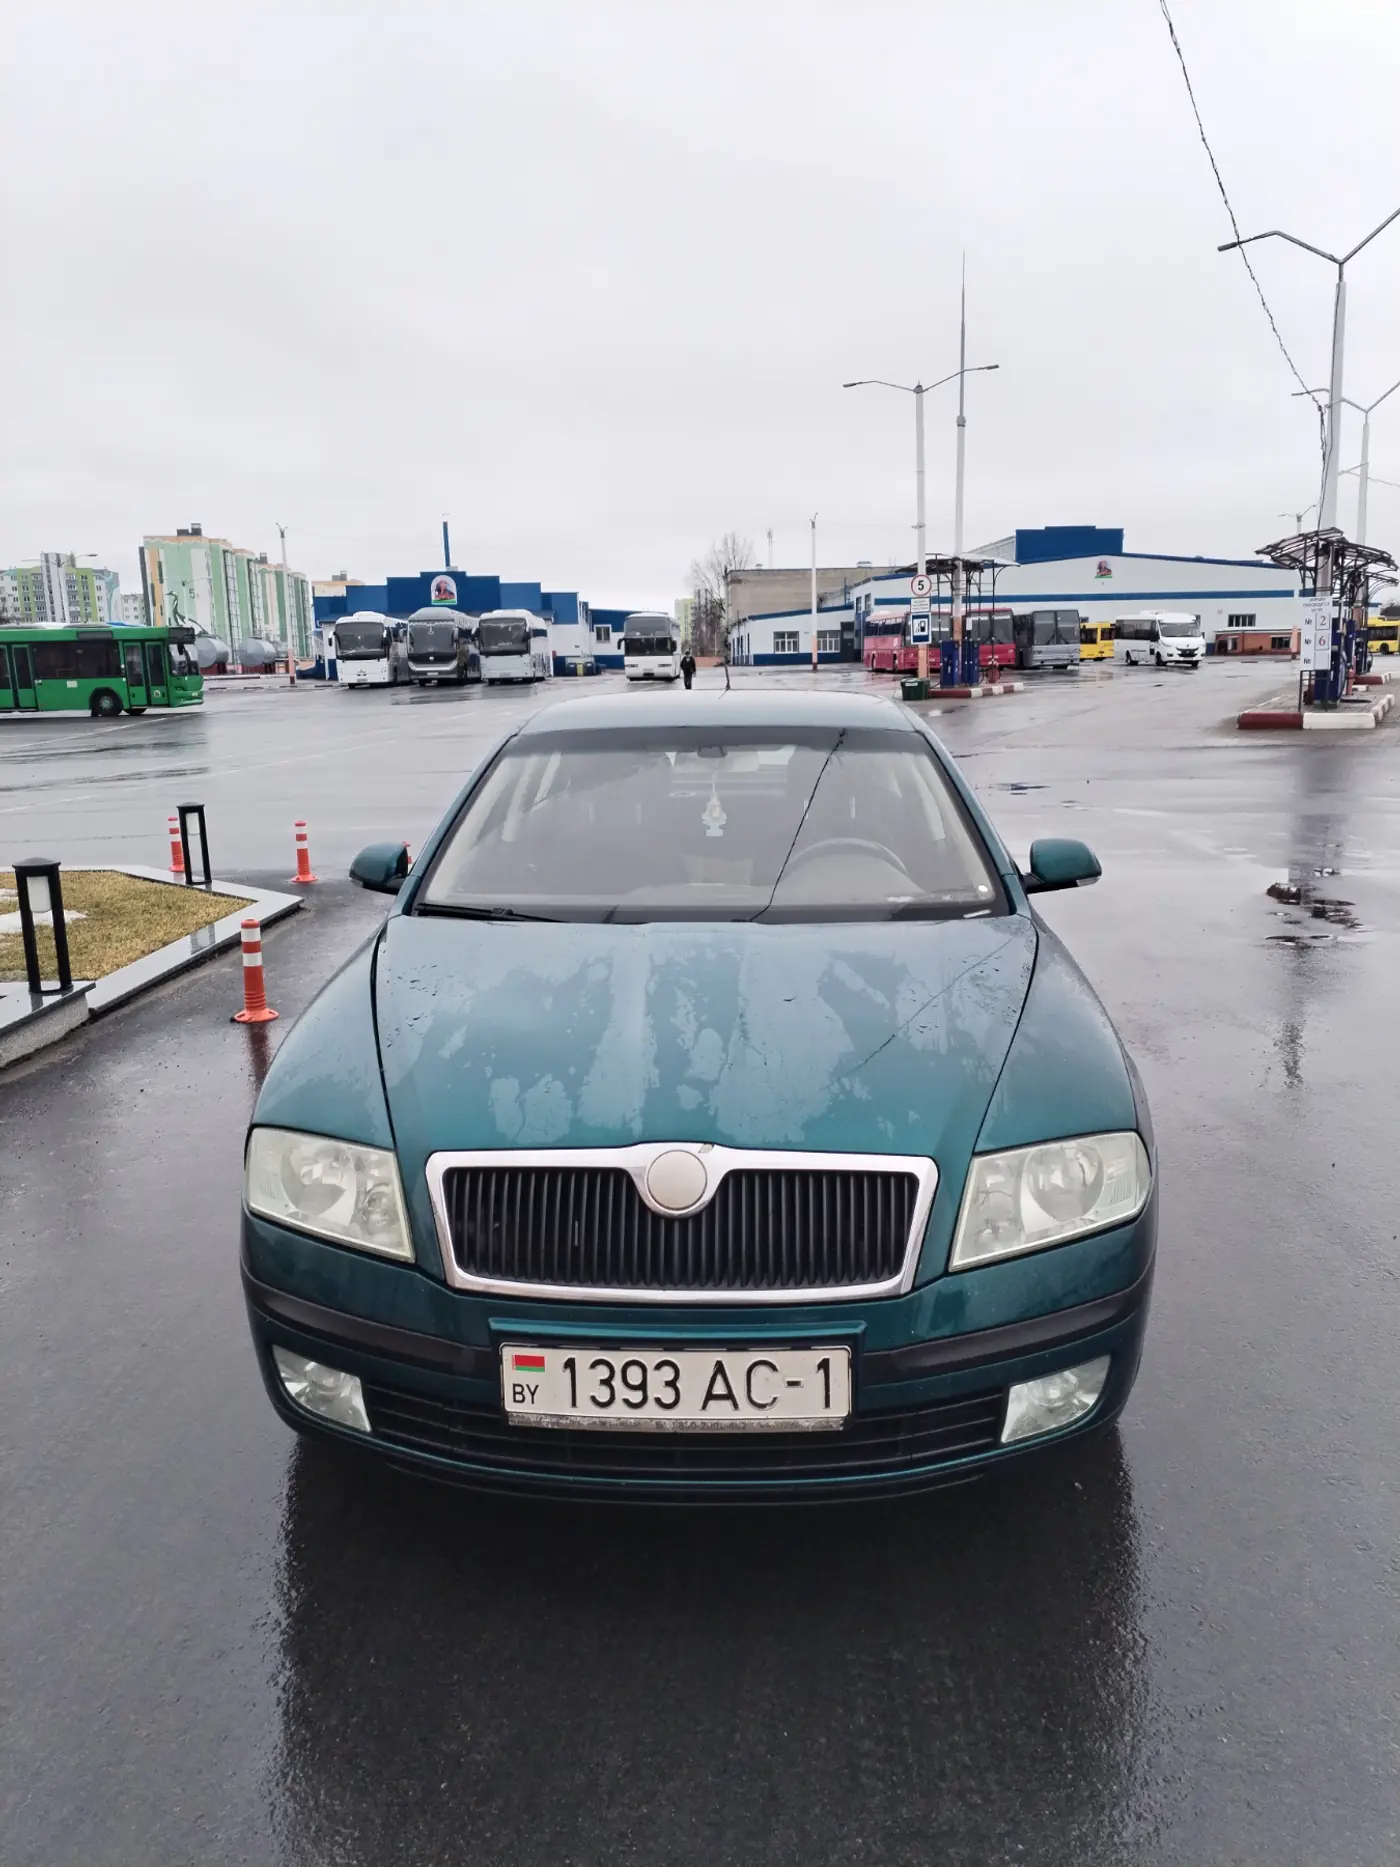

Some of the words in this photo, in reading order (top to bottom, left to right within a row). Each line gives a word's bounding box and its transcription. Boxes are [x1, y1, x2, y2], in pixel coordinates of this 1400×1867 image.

[918, 580, 924, 591] 5
[1320, 616, 1326, 626] 2
[1319, 636, 1326, 646] 6
[562, 1357, 682, 1410] 1393
[699, 1357, 832, 1411] AC-1
[511, 1383, 540, 1405] BY
